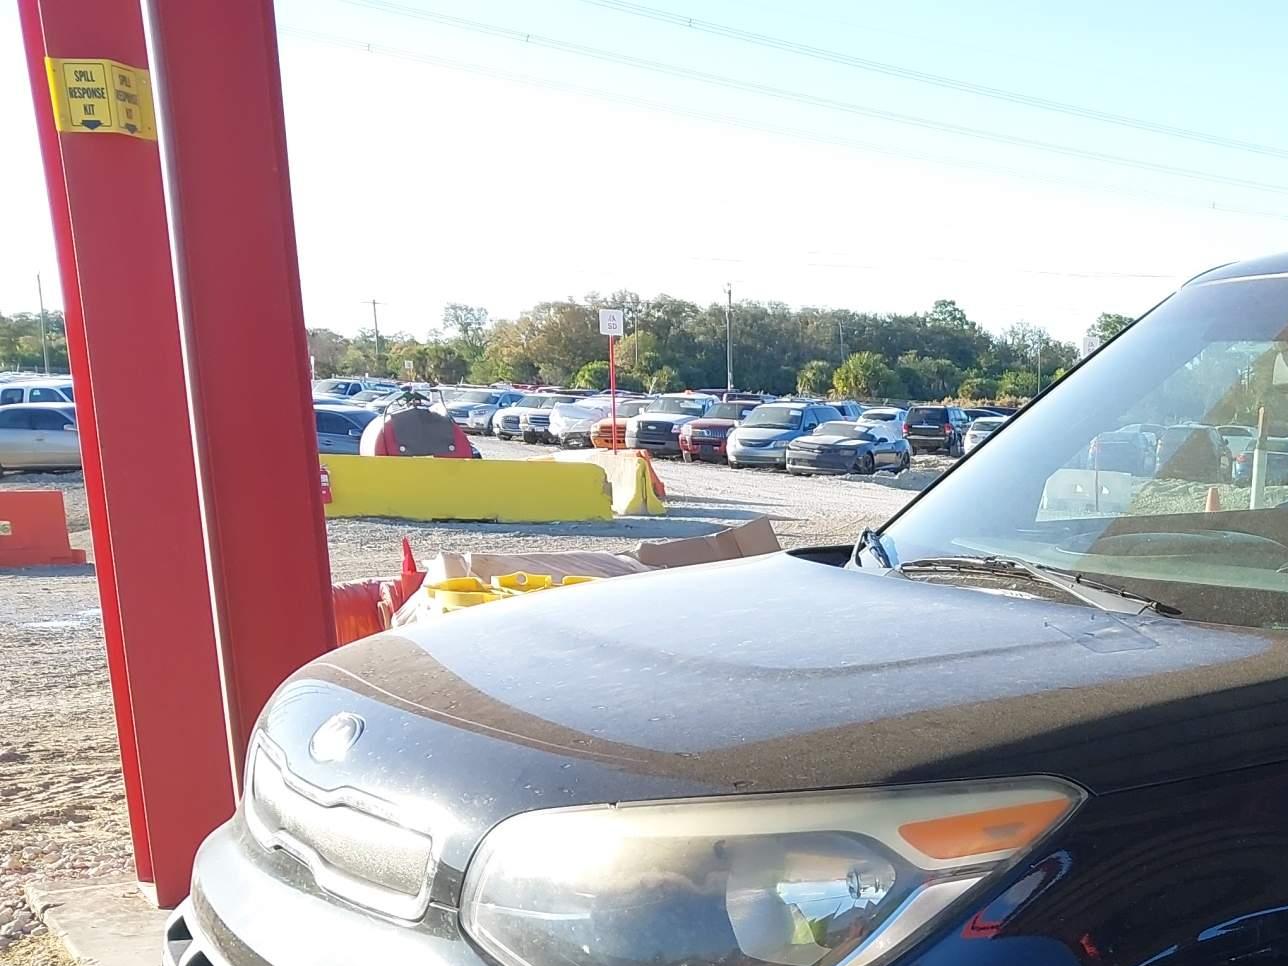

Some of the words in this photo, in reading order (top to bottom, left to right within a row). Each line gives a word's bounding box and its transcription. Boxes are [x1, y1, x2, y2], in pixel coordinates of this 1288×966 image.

[74, 70, 95, 82] SPILL
[68, 86, 106, 99] RESPONSE
[83, 104, 95, 115] KIT
